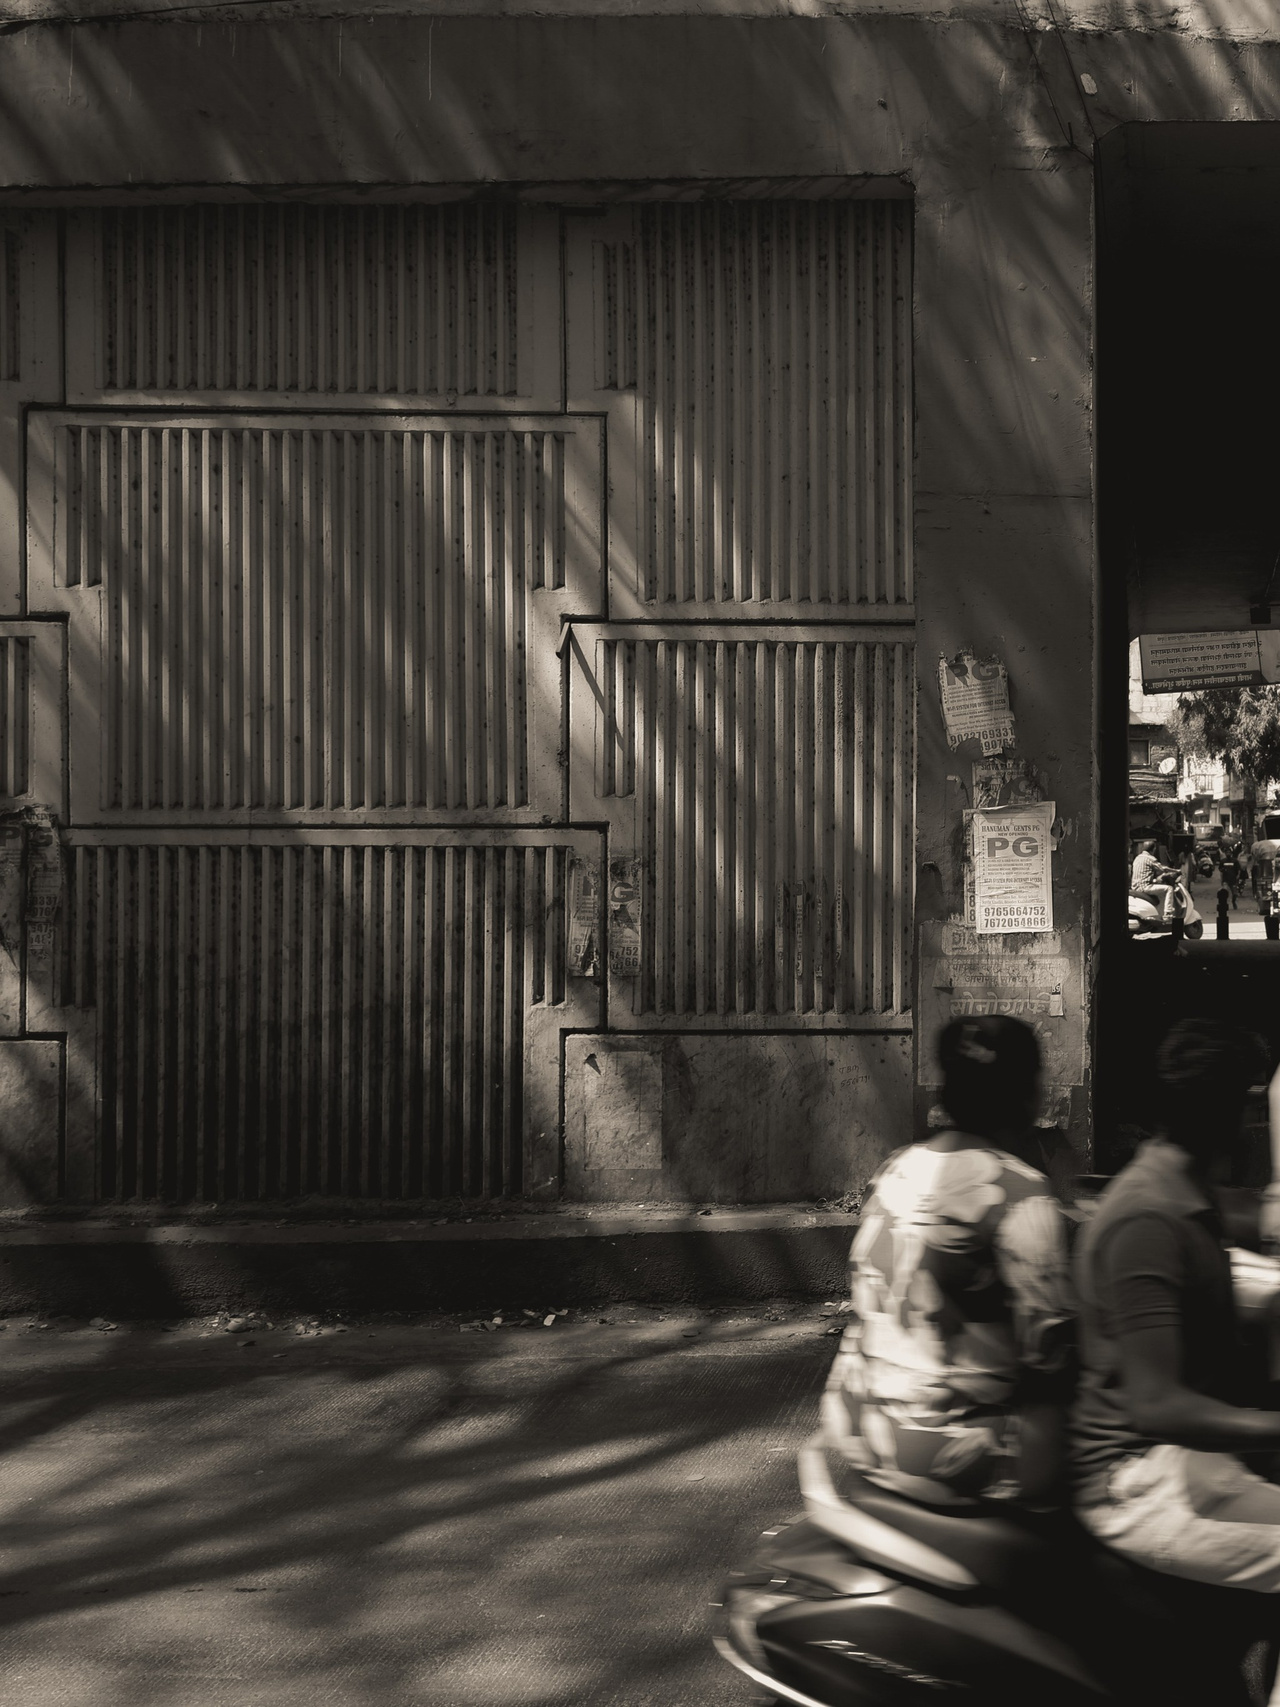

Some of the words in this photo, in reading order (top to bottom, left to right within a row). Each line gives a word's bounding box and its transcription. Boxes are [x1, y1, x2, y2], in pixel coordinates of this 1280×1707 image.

[981, 825, 1010, 833] HANUMAN
[1013, 824, 1031, 832] GENTS
[1032, 824, 1040, 832] PG
[987, 836, 1039, 858] PG
[984, 906, 1046, 917] 9765664752
[984, 917, 1046, 928] 7672054866
